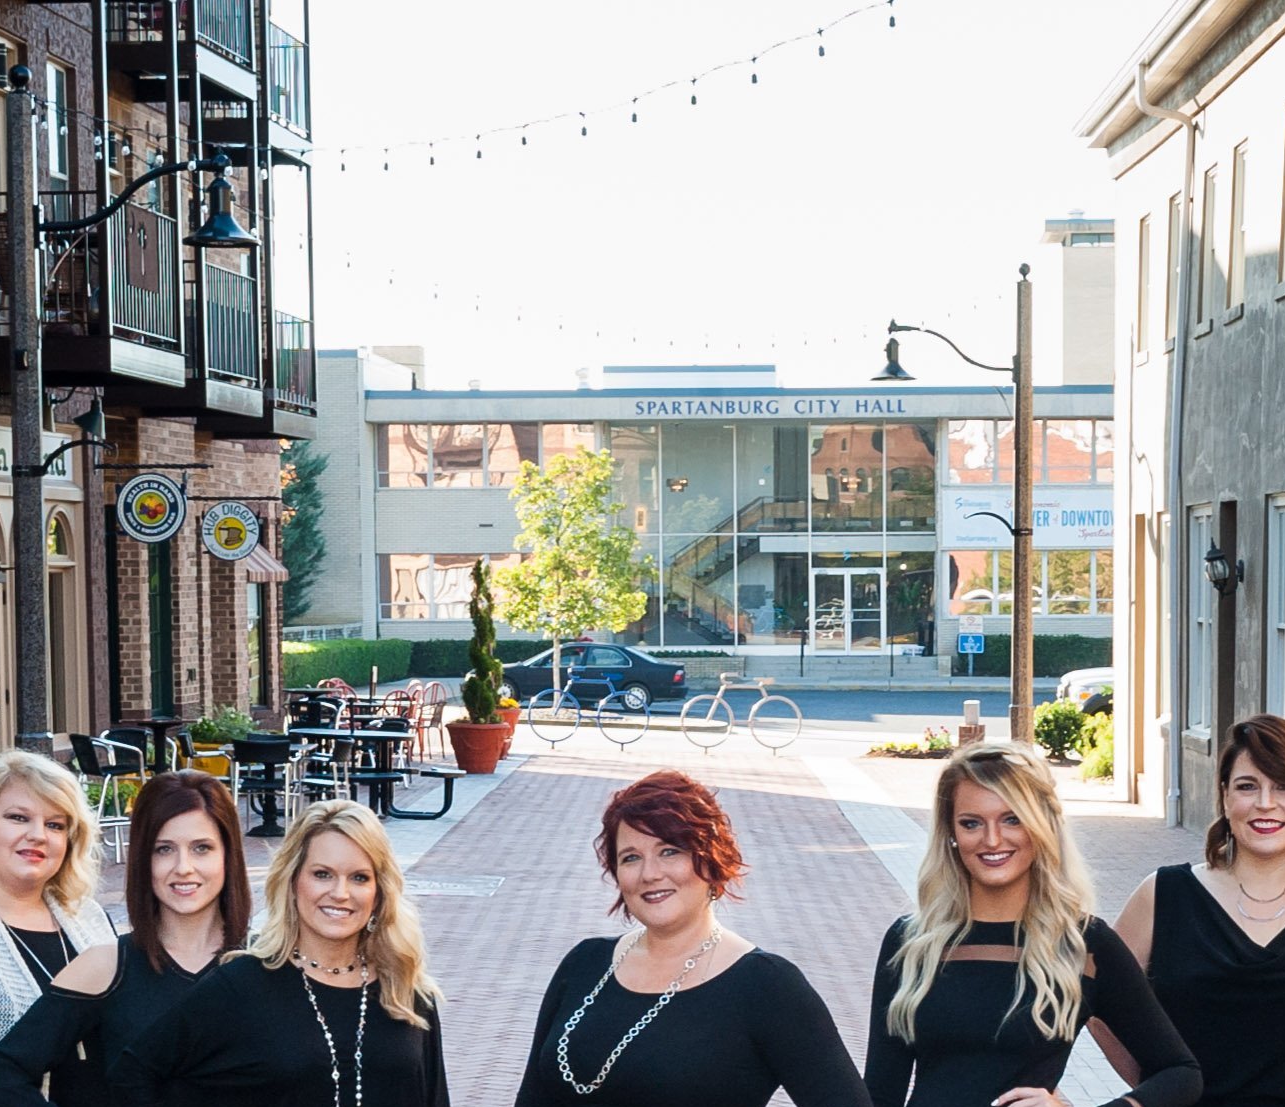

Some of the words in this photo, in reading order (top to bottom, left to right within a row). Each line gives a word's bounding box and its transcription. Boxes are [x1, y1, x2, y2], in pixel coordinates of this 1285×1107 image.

[635, 399, 780, 416] SPARTANBURG
[794, 398, 841, 414] CITY
[855, 398, 907, 414] HALL
[126, 481, 149, 504] HEALTH
[203, 510, 220, 536] HUB
[221, 503, 258, 536] DIGGITY
